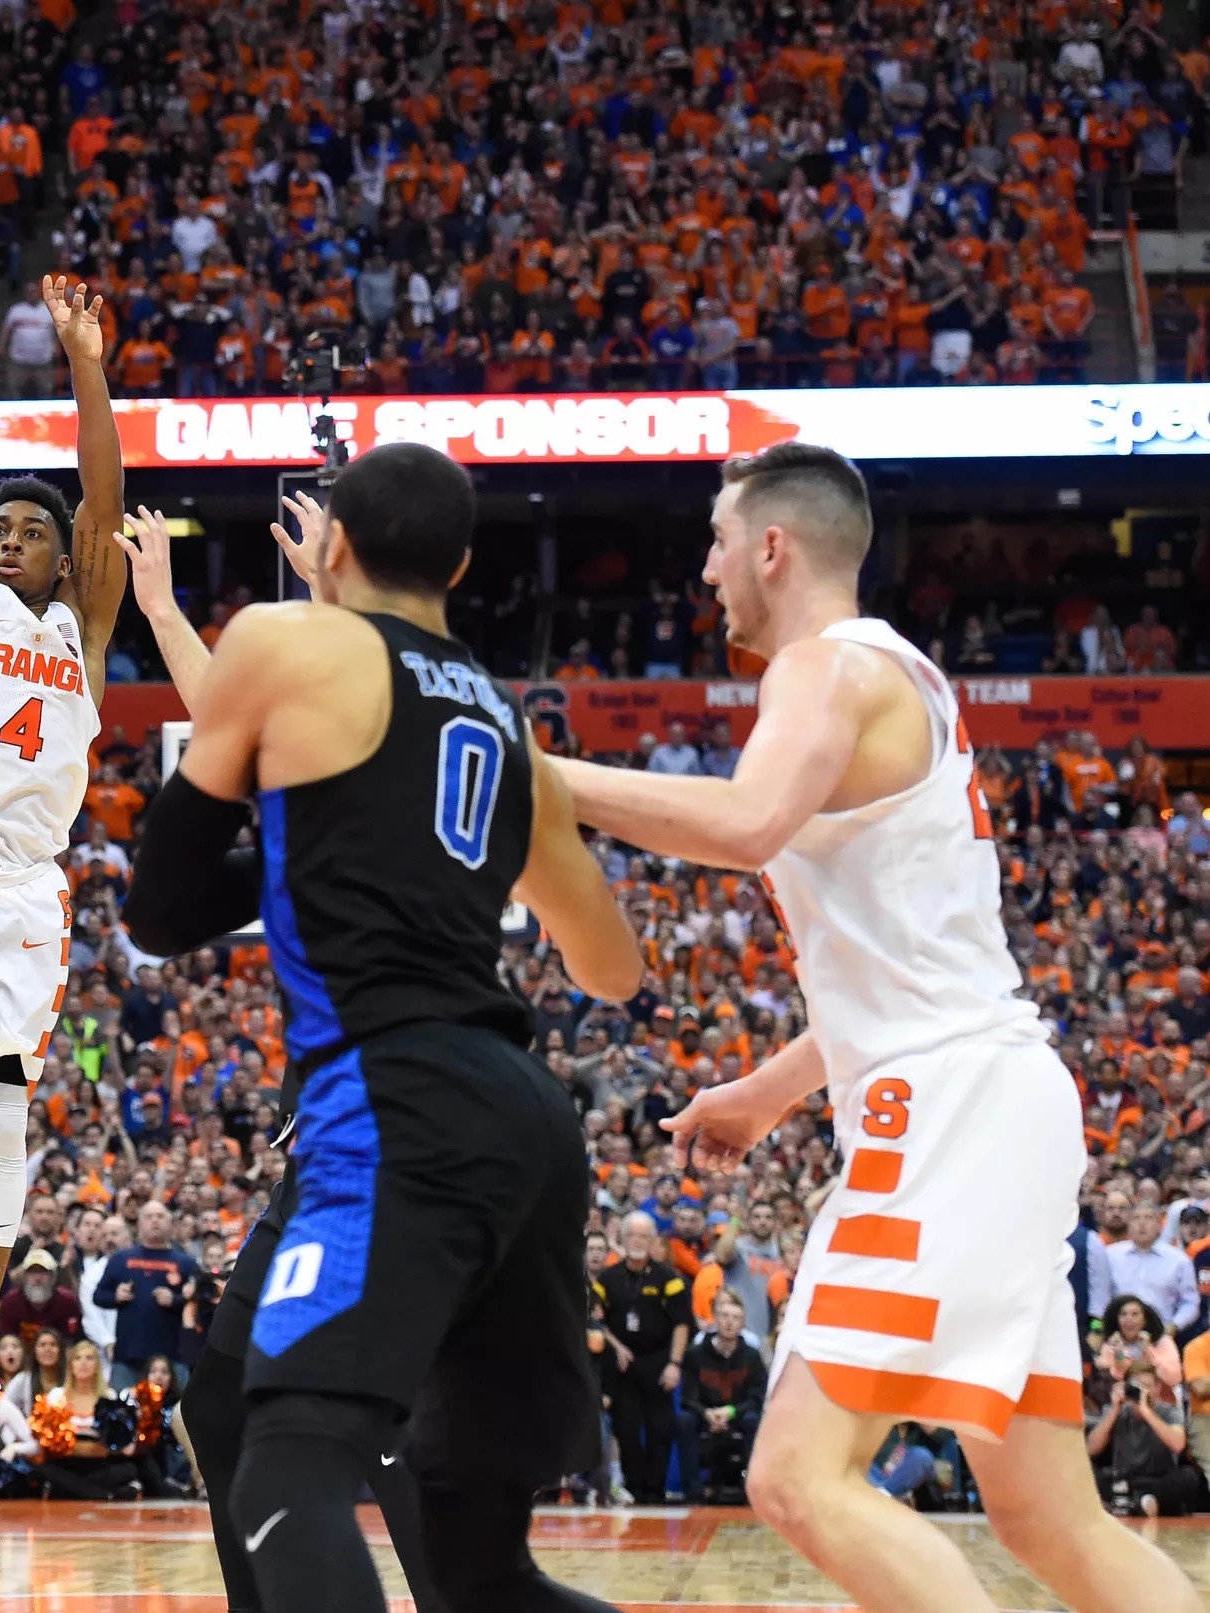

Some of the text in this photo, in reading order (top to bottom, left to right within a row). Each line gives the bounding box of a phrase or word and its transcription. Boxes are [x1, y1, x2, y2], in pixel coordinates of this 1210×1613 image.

[374, 397, 730, 457] SPONSOR
[966, 680, 1031, 704] TEAM
[435, 715, 505, 871] 0
[861, 1077, 912, 1140] S
[259, 1241, 324, 1307] D
